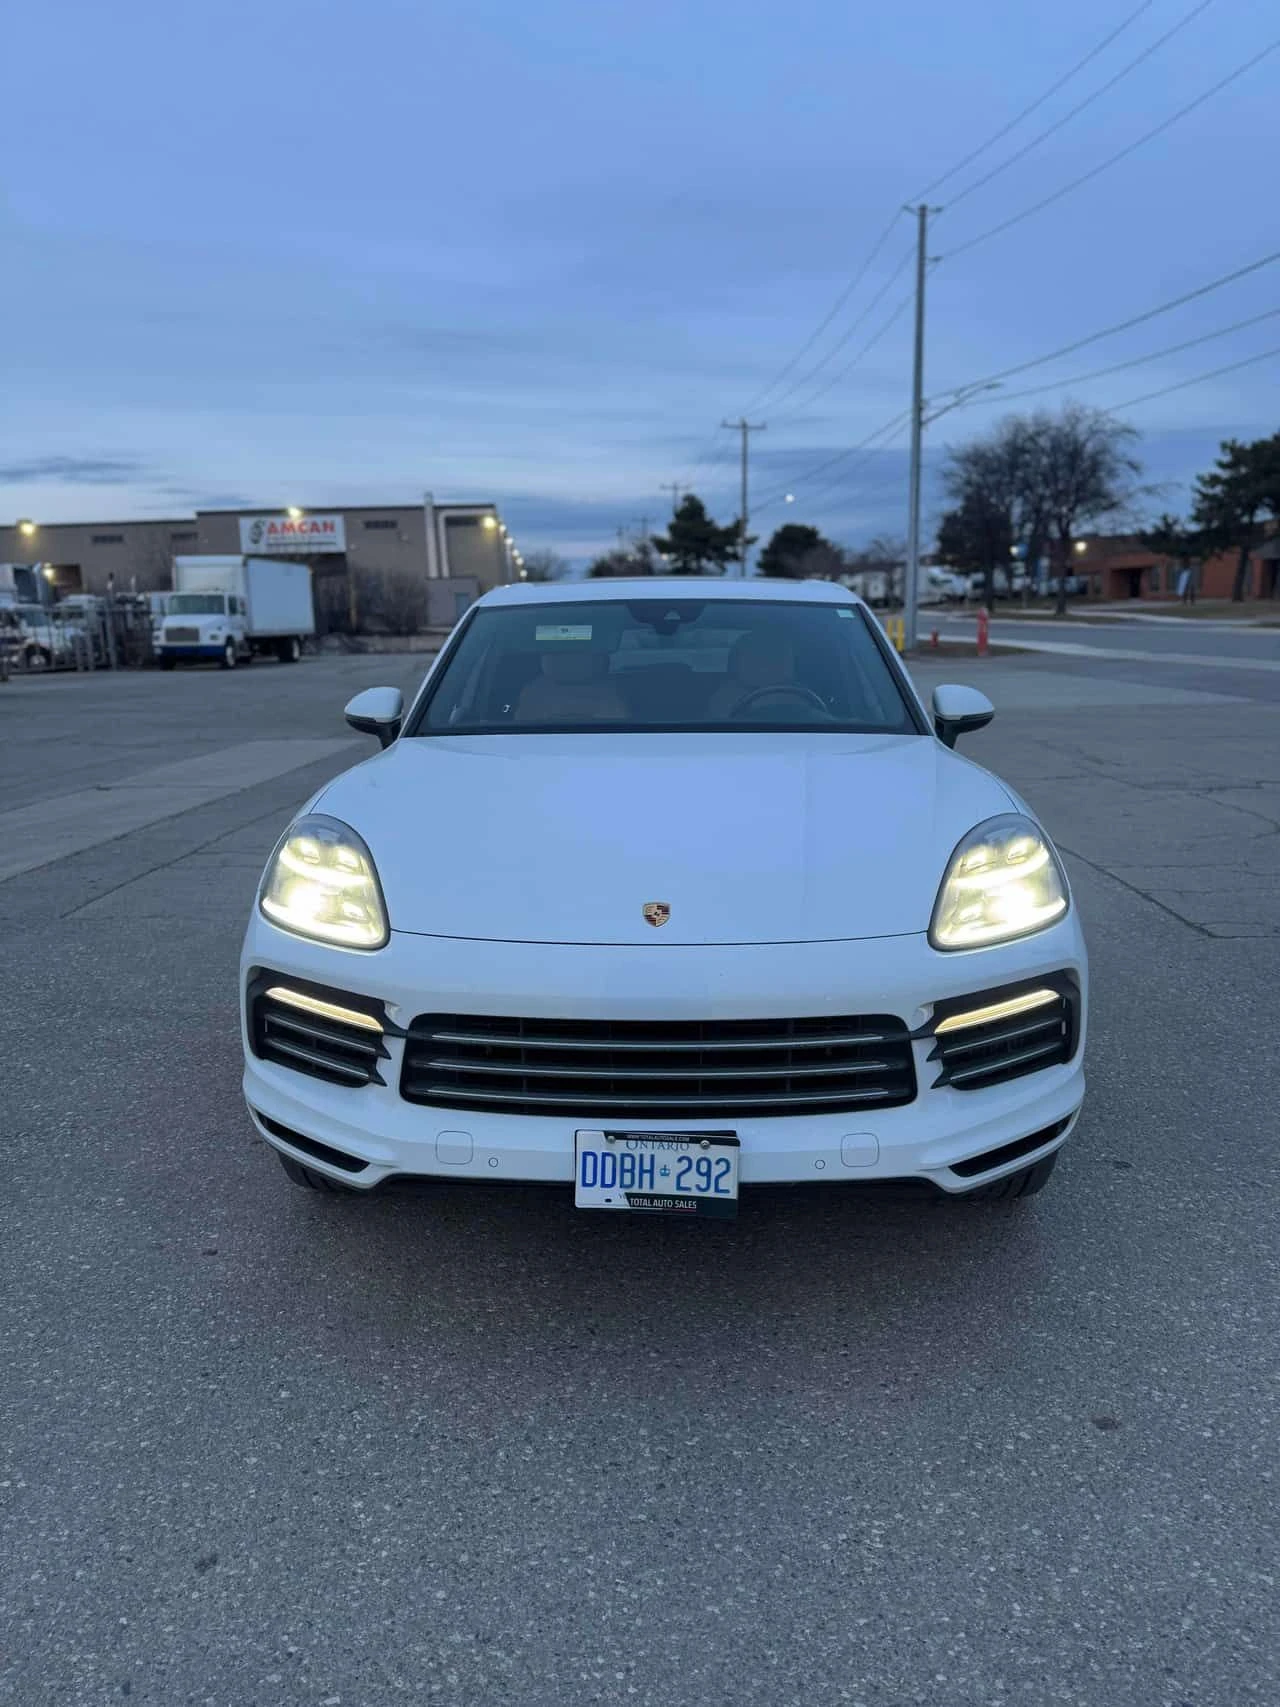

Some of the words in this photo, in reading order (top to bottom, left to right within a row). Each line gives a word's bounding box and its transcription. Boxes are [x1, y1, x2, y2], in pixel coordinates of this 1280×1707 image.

[626, 1140, 690, 1152] ONTARIO
[581, 1151, 655, 1190] DDBH
[675, 1155, 731, 1194] 292
[630, 1198, 652, 1207] TOTAL
[653, 1199, 673, 1208] AUTO
[675, 1200, 697, 1209] SALES
